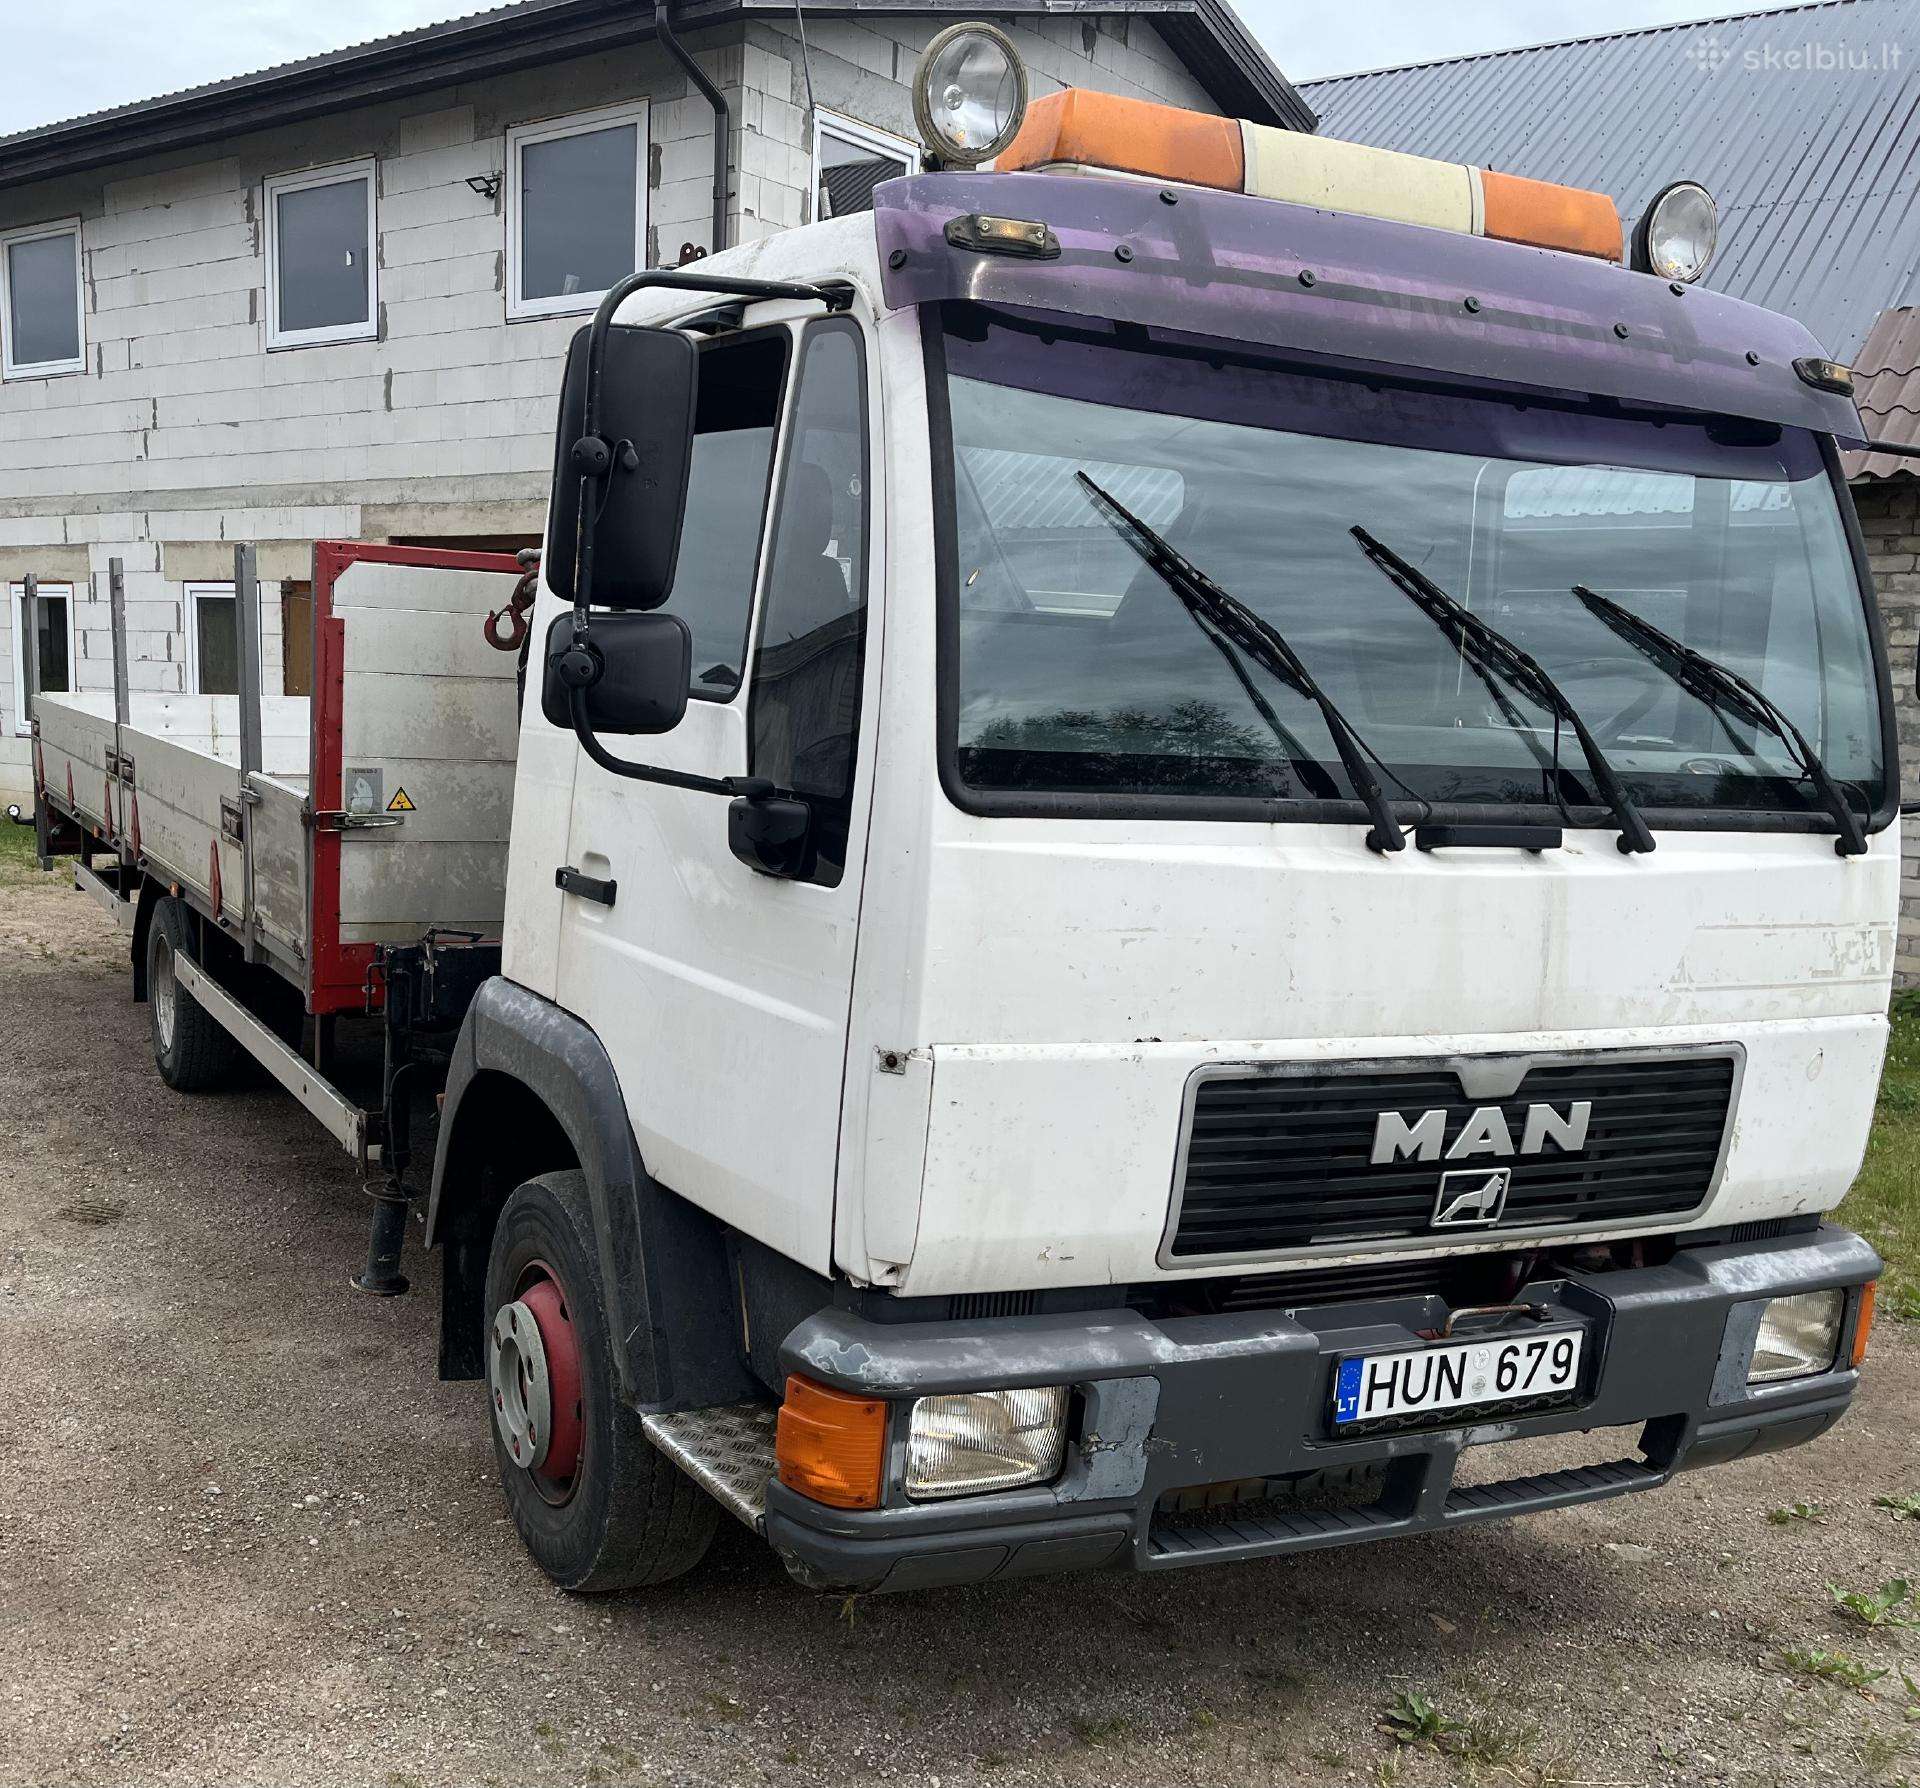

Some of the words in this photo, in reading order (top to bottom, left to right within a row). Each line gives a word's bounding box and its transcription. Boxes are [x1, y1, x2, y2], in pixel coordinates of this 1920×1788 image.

[1370, 1101, 1592, 1164] MAN
[1337, 1396, 1356, 1412] LT
[1365, 1352, 1467, 1412] HUN
[1495, 1338, 1574, 1392] 679
